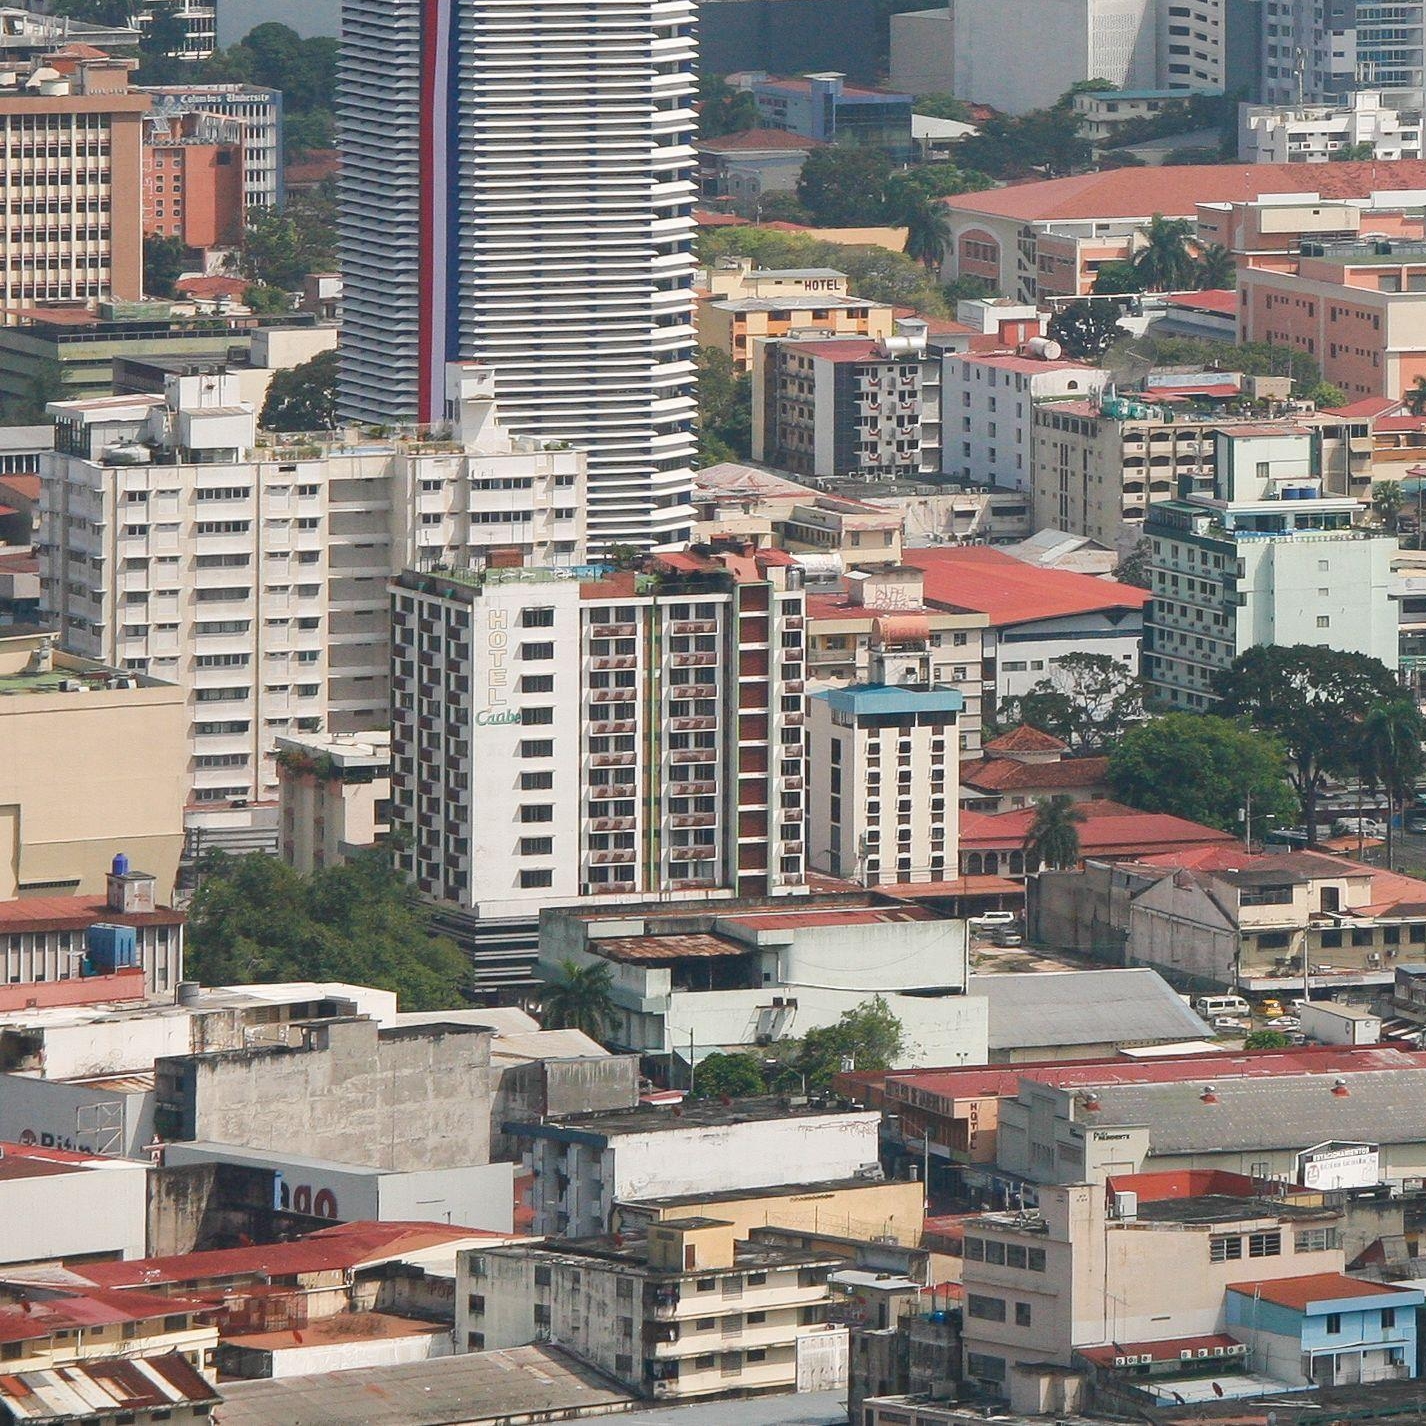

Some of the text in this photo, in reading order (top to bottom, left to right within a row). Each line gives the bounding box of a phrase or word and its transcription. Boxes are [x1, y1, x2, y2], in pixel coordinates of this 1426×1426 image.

[180, 94, 222, 104] Columbus
[804, 278, 841, 291] HOTEL
[488, 609, 508, 706] HOTEL
[970, 1102, 978, 1150] HOTEL
